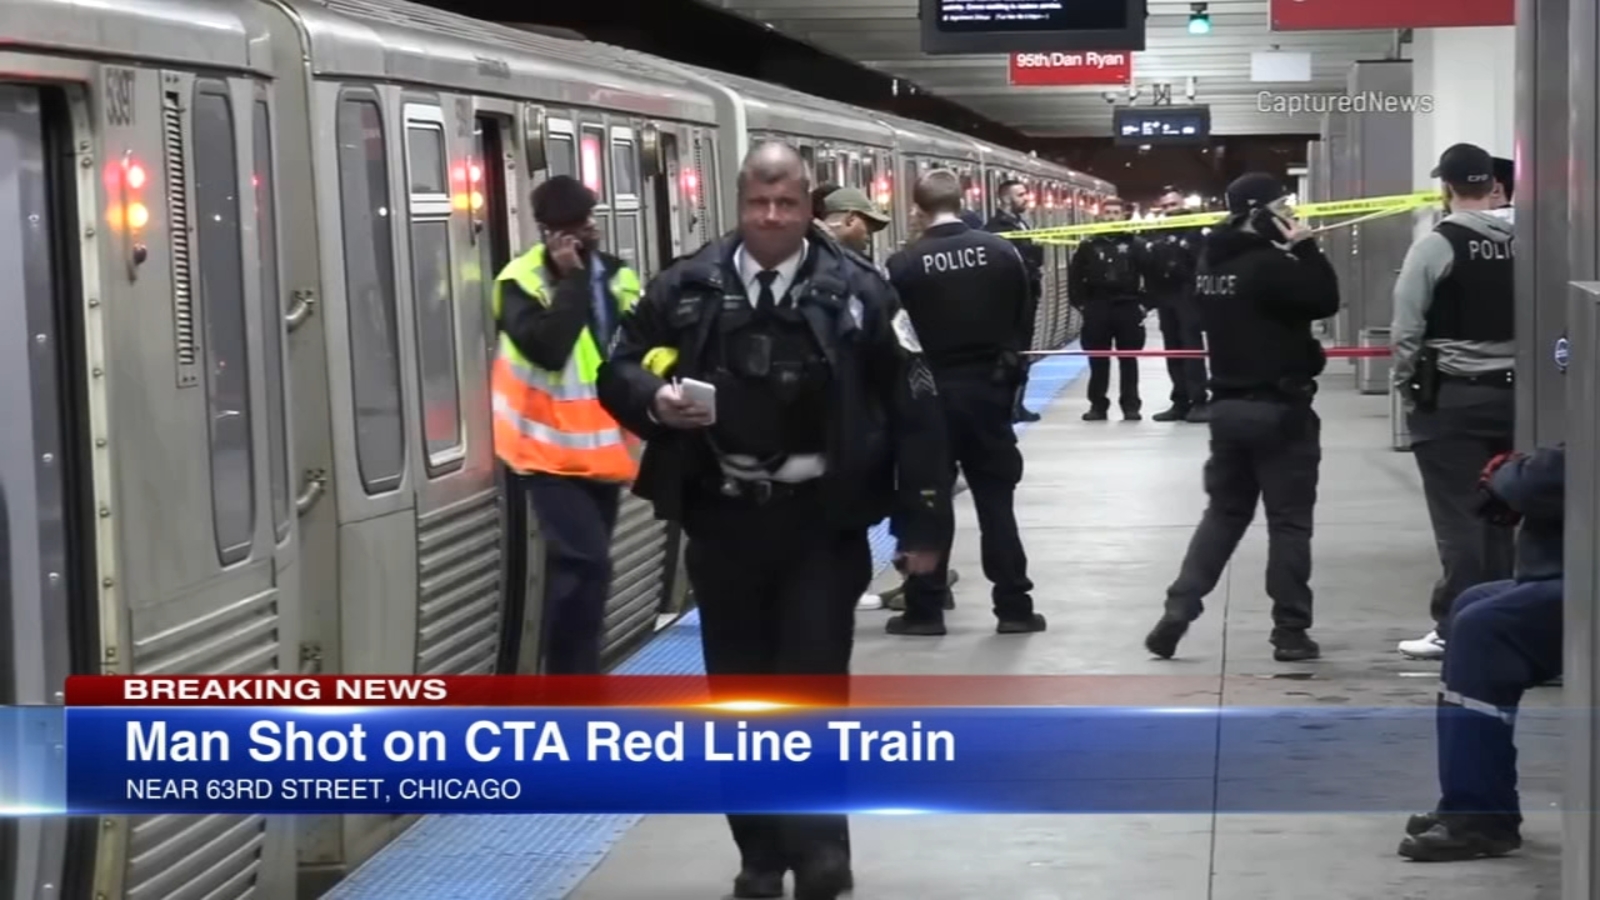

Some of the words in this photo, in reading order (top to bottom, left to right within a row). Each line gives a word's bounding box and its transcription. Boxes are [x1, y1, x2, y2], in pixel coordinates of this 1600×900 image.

[1016, 52, 1082, 68] 95th/Dan
[1086, 52, 1125, 69] Ryan
[922, 246, 988, 274] POLICE
[1195, 274, 1237, 296] POLICE
